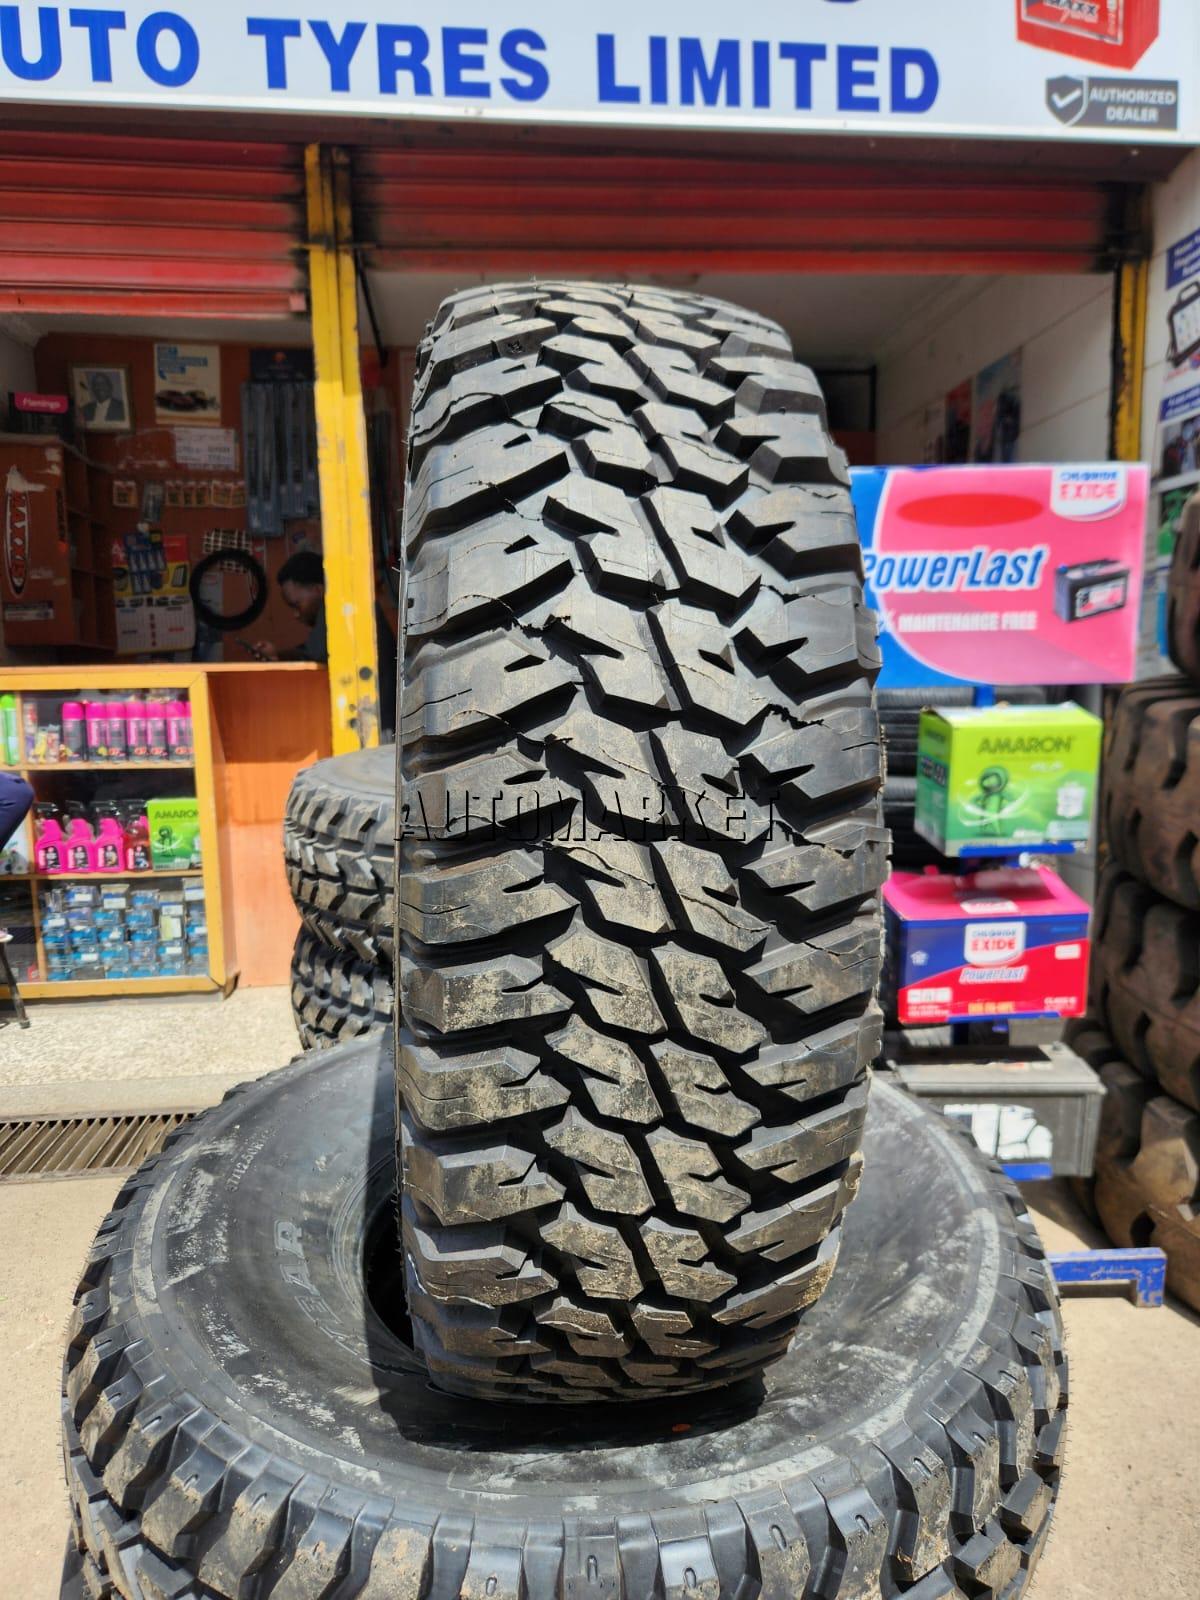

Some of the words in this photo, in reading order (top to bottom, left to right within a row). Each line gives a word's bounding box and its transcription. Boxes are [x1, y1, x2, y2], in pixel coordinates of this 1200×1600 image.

[0, 6, 200, 88] UTO
[246, 17, 550, 102] TYRES
[596, 33, 940, 114] LIMITED
[1089, 87, 1177, 105] AUTHORIZED
[1105, 106, 1159, 122] DEALER
[1059, 483, 1117, 499] EXIDE
[898, 612, 999, 632] MAINTENANCE
[1001, 611, 1037, 630] FREE
[978, 736, 1074, 755] AMARON
[971, 938, 1016, 952] EXIDE
